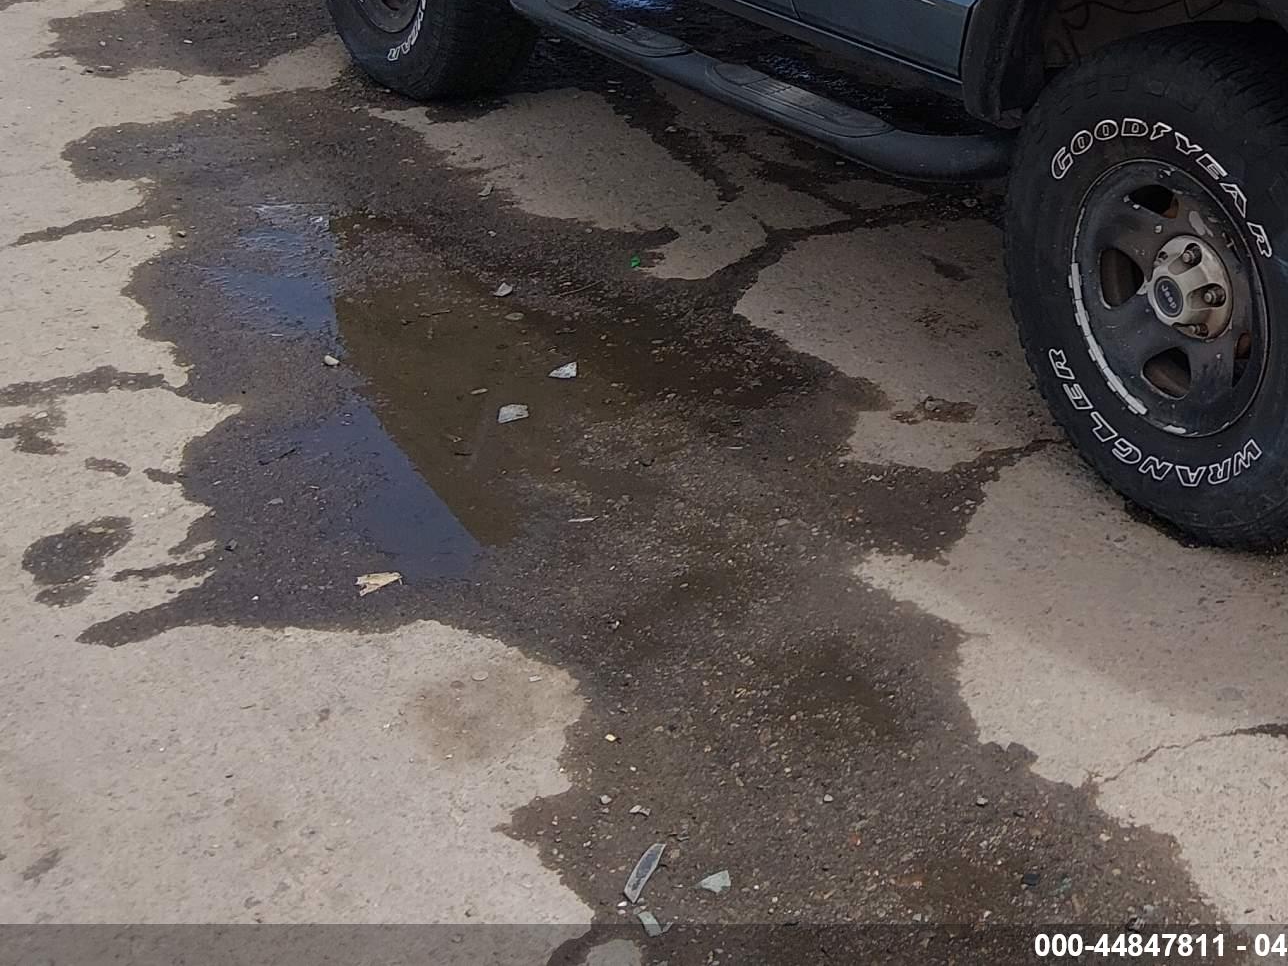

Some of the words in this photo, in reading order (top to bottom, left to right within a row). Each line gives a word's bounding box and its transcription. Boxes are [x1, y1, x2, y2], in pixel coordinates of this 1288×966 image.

[1051, 118, 1272, 258] GOODYEAR
[1161, 284, 1178, 309] Jeep
[1048, 348, 1262, 487] WRANGLER
